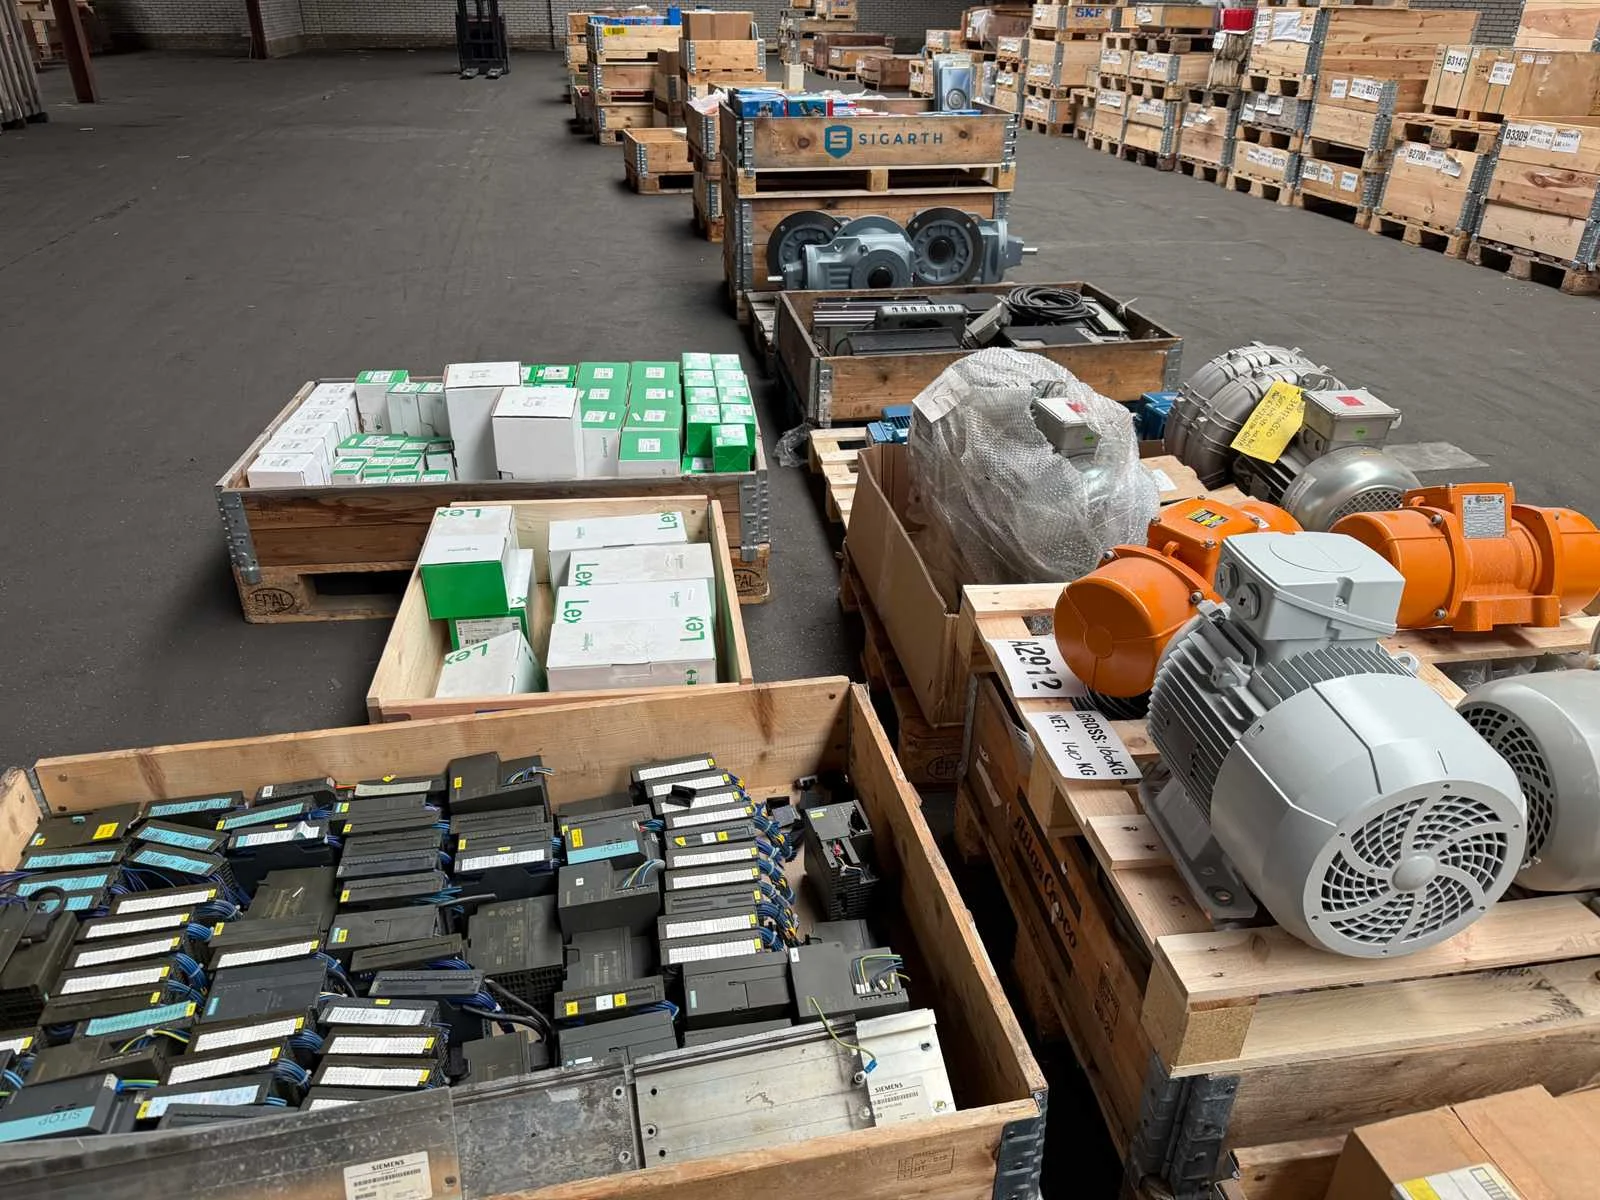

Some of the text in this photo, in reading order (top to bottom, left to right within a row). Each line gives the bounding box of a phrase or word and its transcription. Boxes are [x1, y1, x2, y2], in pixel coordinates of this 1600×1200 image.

[1075, 7, 1104, 18] SKF
[858, 132, 943, 146] SIGARTH
[1505, 128, 1529, 142] B3309
[575, 563, 600, 587] Lex
[680, 616, 705, 641] Lex
[1076, 713, 1108, 744] GROSS:
[1047, 714, 1070, 733] NET:
[1076, 763, 1097, 776] KG
[874, 1082, 904, 1093] SIEMENS
[371, 1159, 406, 1171] SIEMENS
